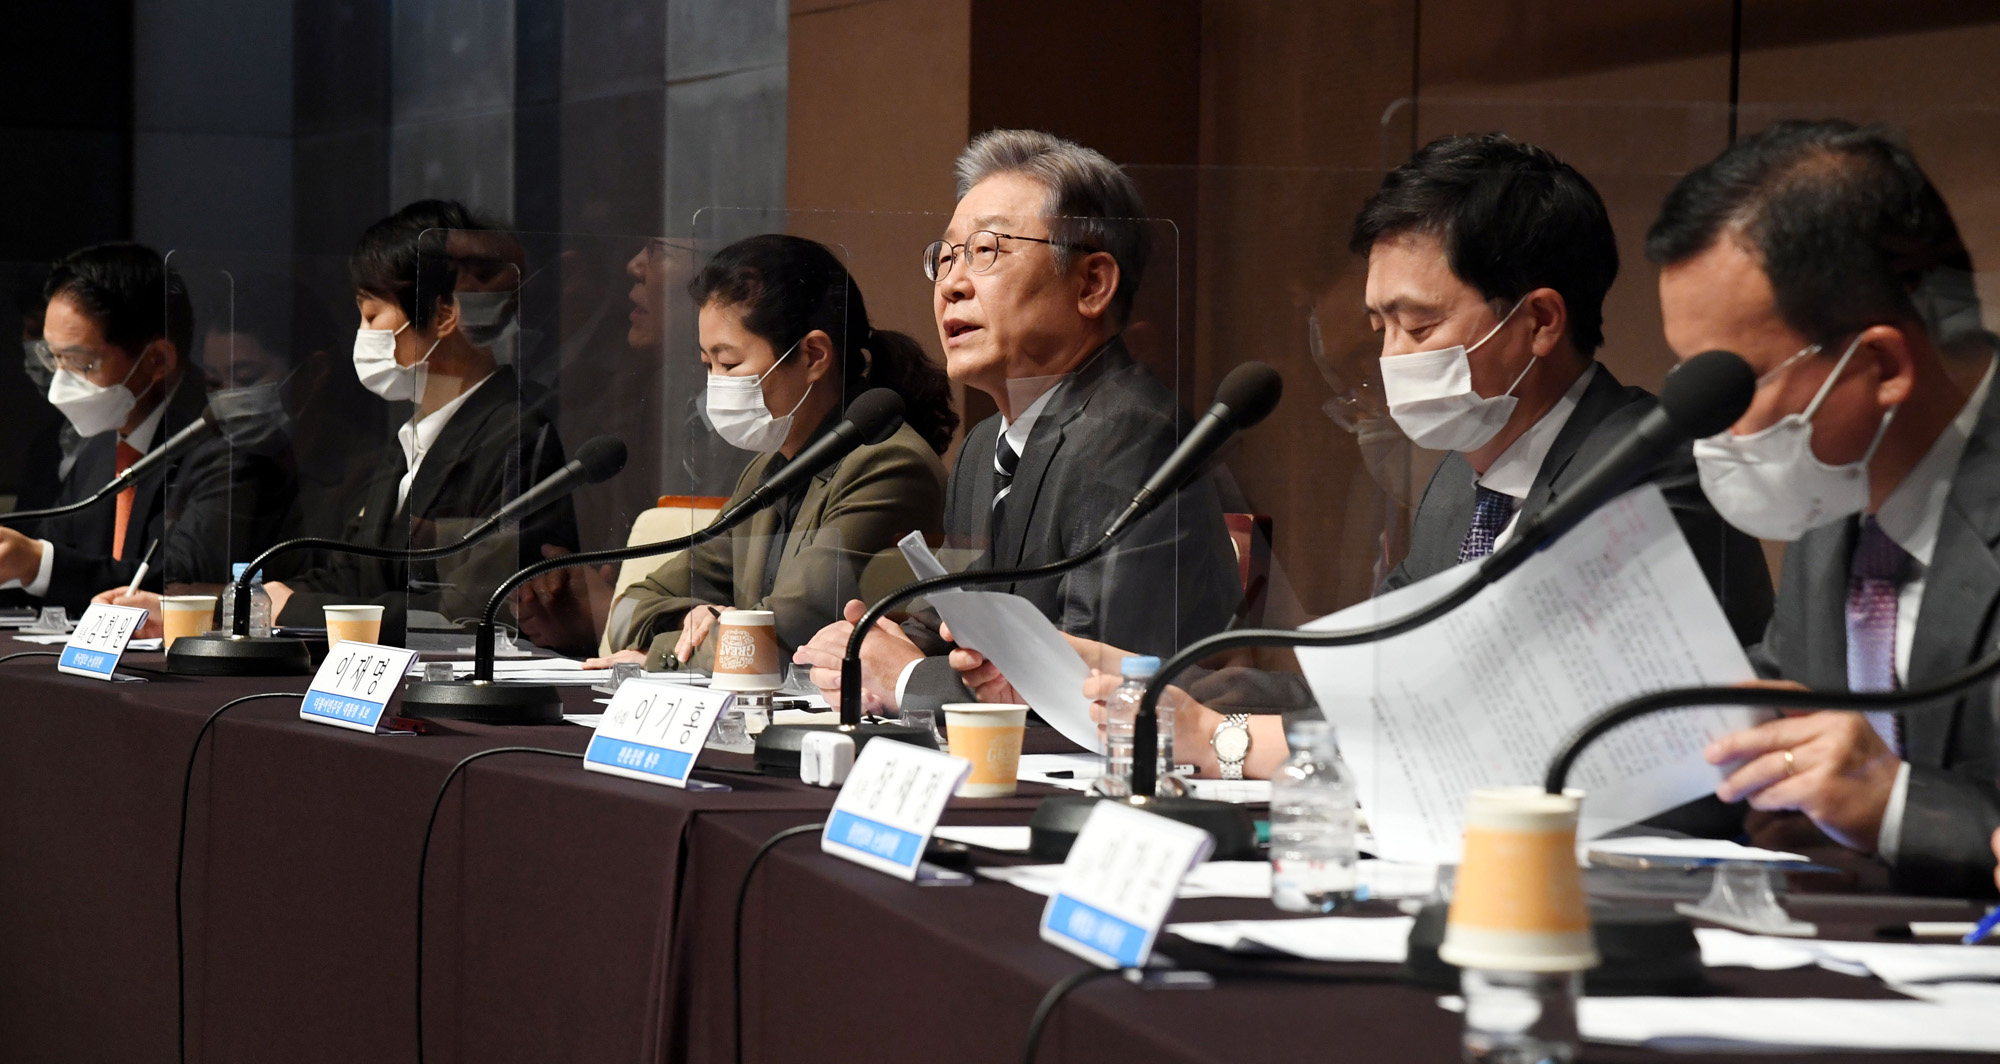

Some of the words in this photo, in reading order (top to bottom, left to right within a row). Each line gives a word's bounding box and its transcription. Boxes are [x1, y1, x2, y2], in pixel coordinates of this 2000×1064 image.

[719, 642, 756, 658] GREAT
[336, 651, 391, 695] 이재명
[634, 693, 706, 745] 이기홍
